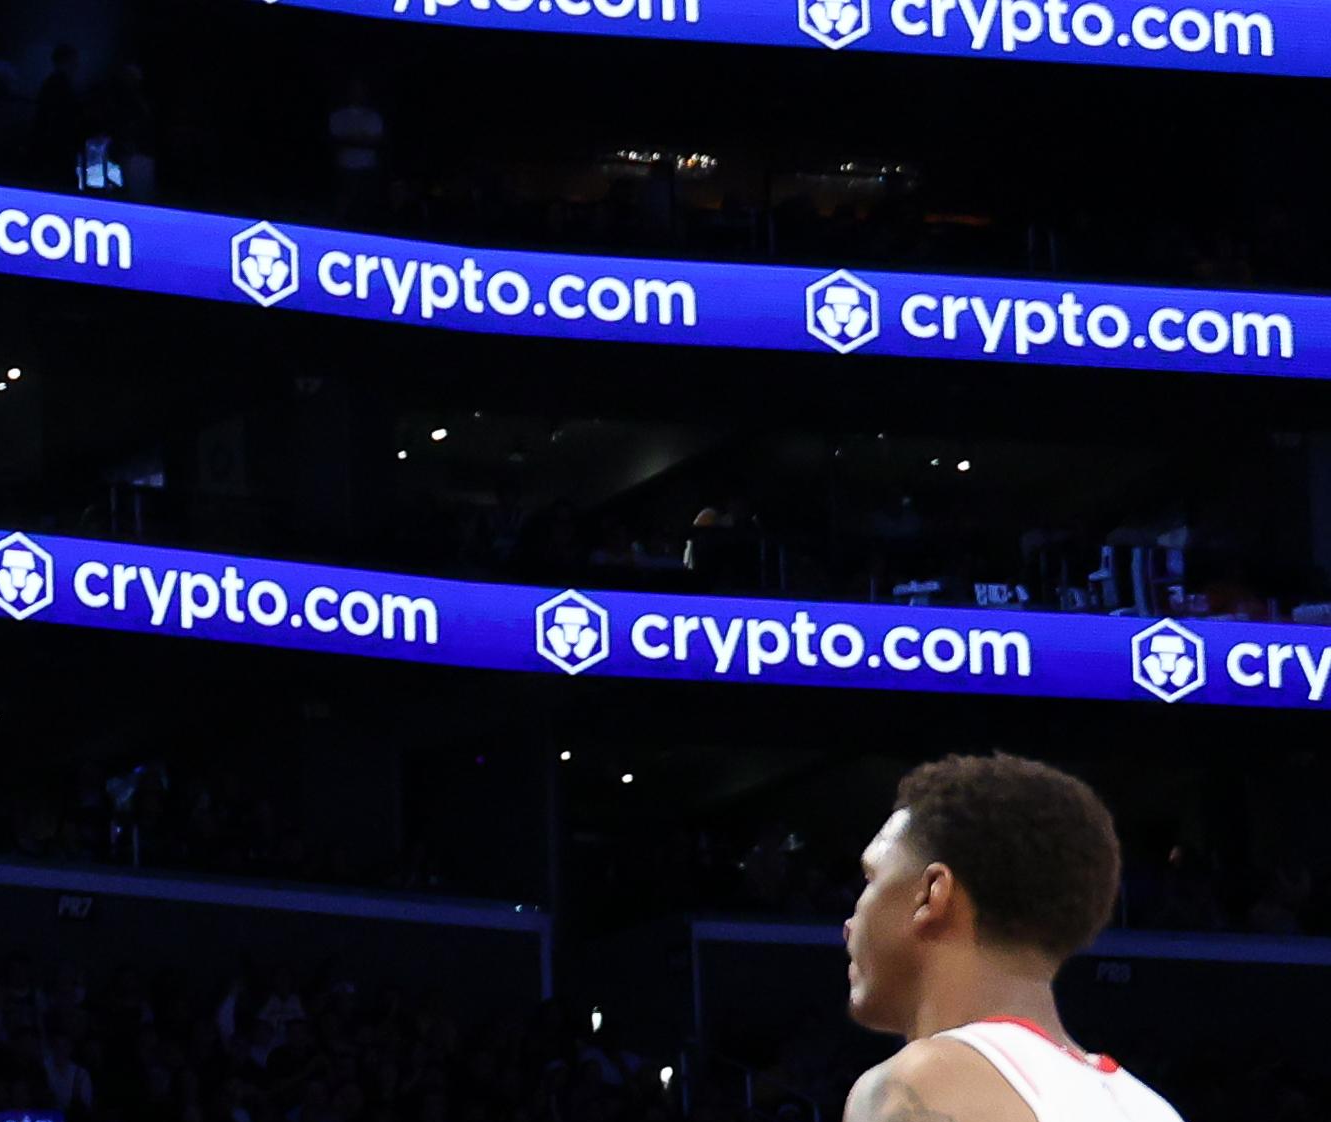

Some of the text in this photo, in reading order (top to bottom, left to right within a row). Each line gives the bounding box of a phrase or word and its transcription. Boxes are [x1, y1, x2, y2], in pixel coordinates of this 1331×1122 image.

[890, 0, 1275, 57] crypto.com
[318, 250, 697, 327] crypto.com
[901, 292, 1294, 359] crypto.com
[73, 560, 439, 645] crypto.com
[631, 611, 1032, 677] crypto.com
